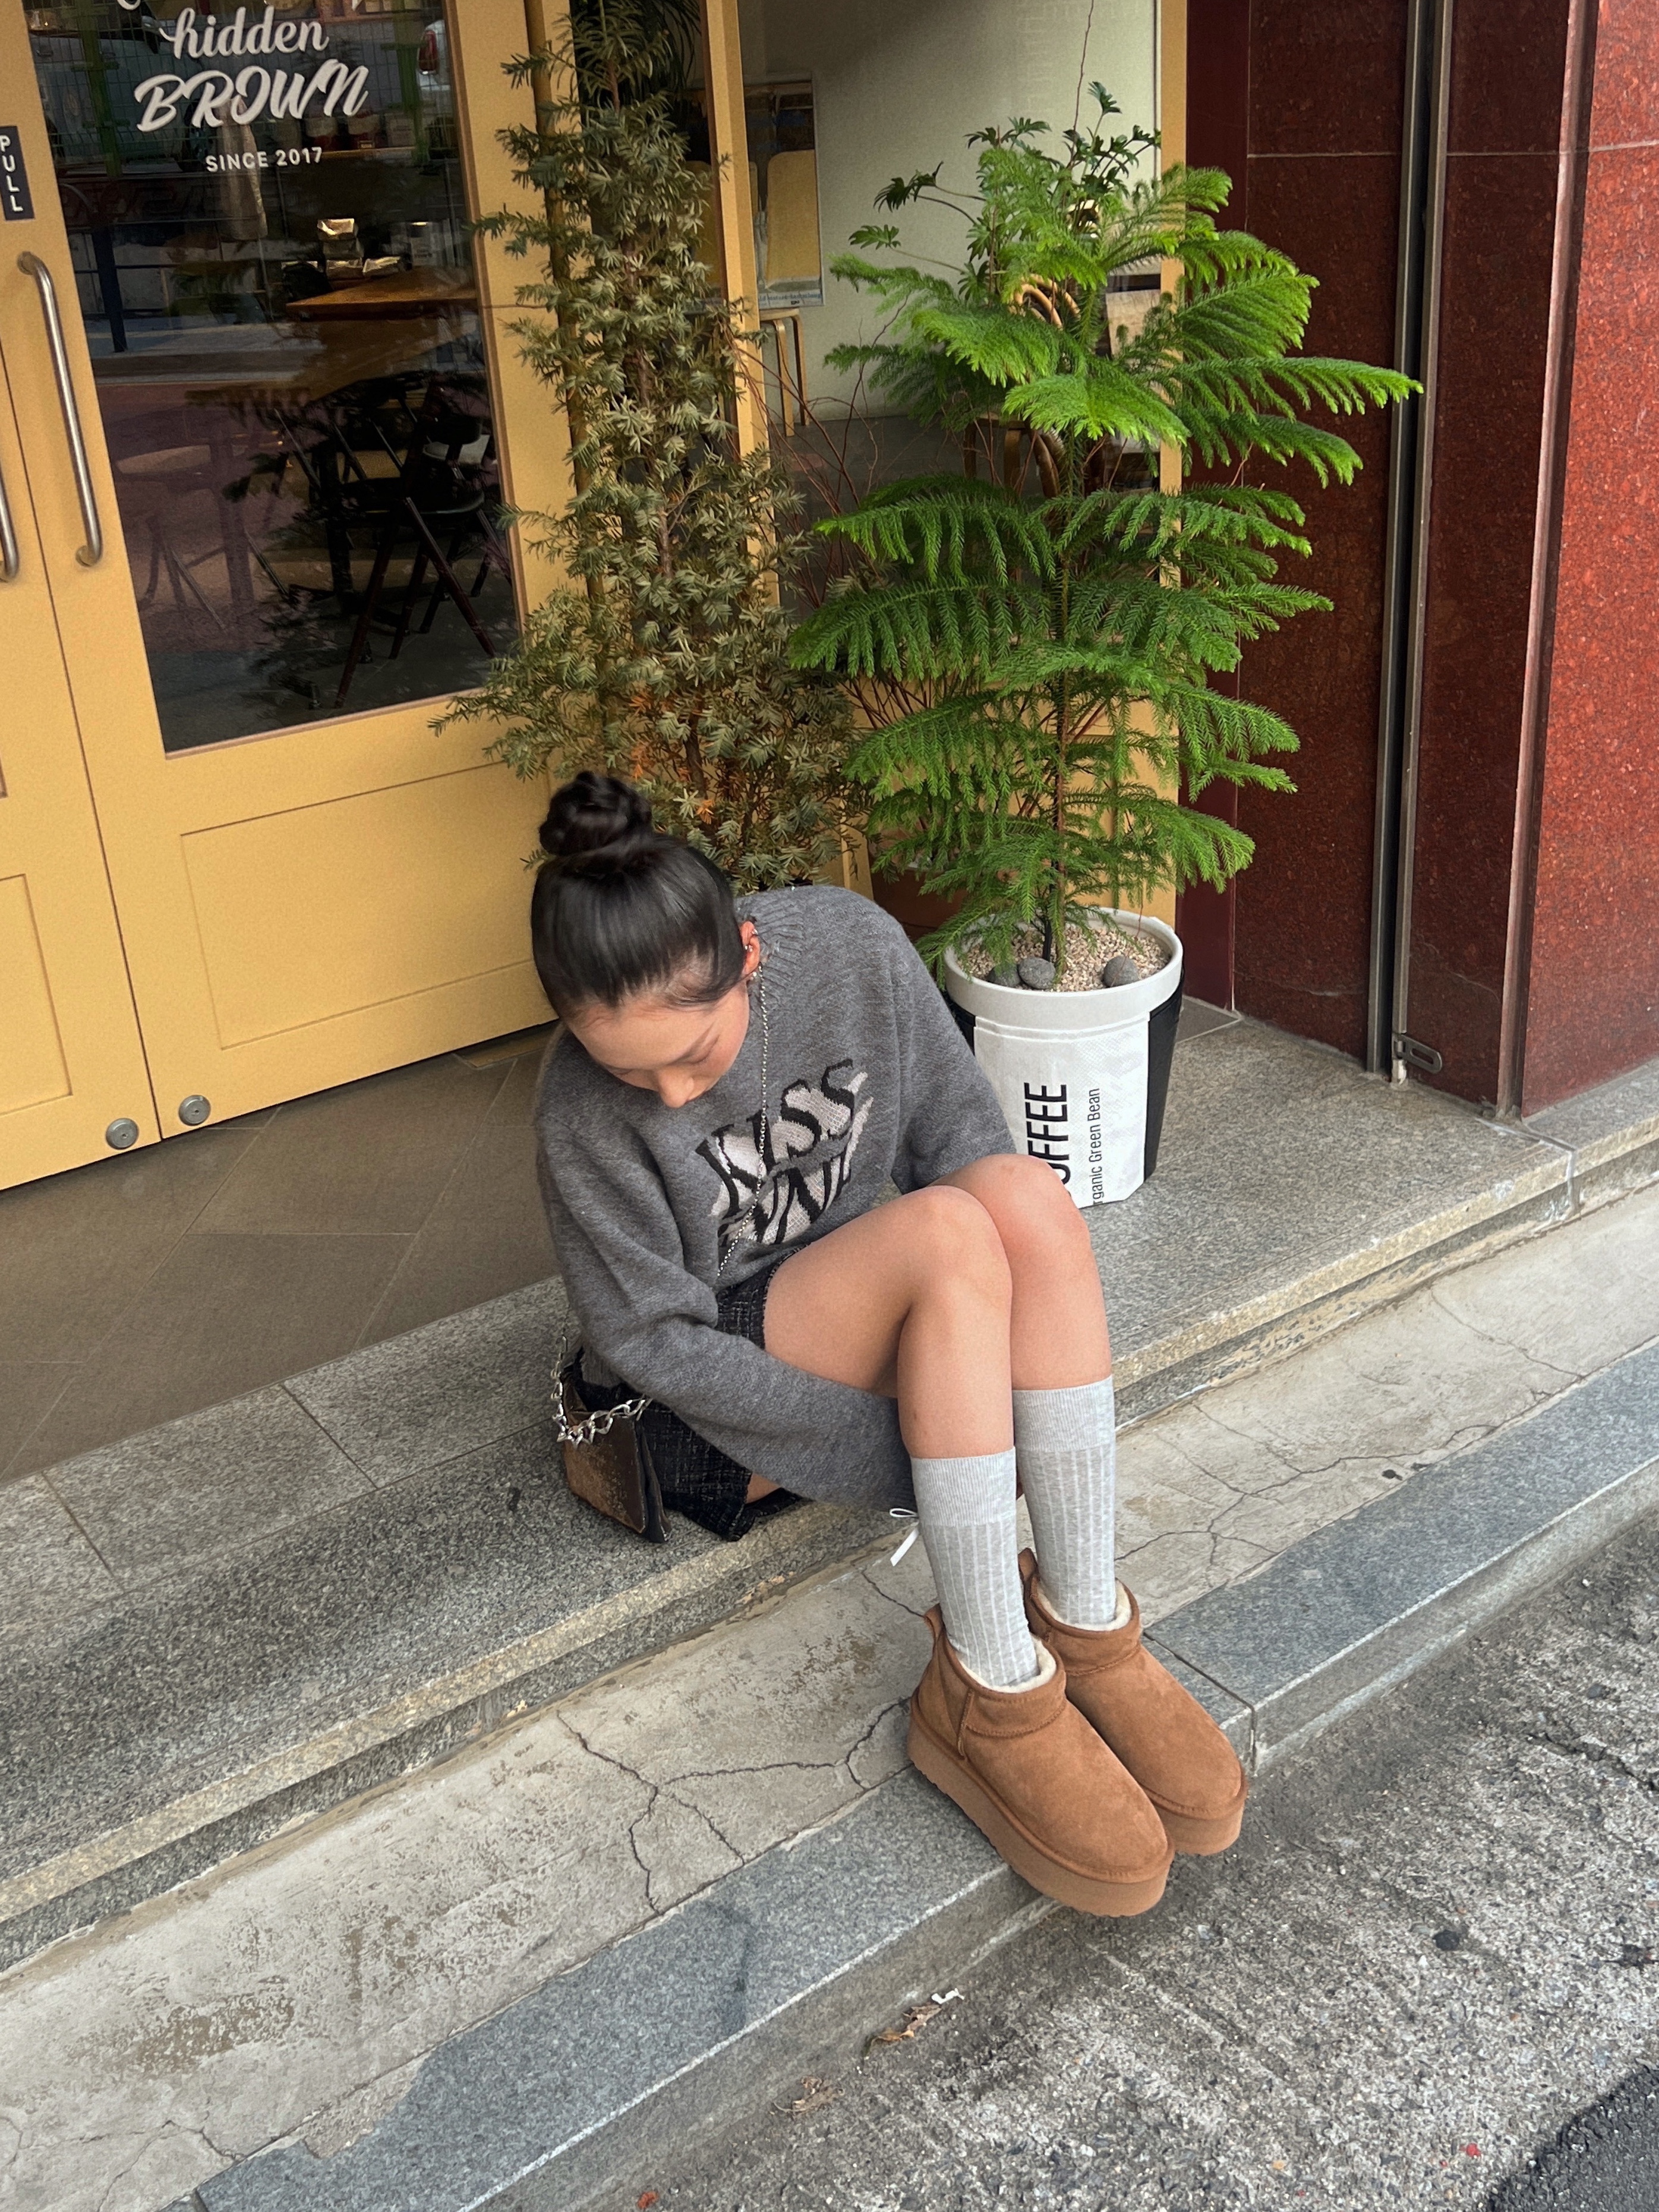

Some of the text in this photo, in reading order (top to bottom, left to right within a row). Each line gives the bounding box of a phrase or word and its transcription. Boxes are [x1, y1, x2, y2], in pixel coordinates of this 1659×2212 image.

[159, 6, 329, 59] hidden
[134, 59, 369, 132] BROWN
[0, 135, 24, 212] PULL
[206, 147, 323, 172] SINCE 2017
[695, 1058, 854, 1220] KISS
[1087, 1088, 1105, 1205] rganic Green Bean
